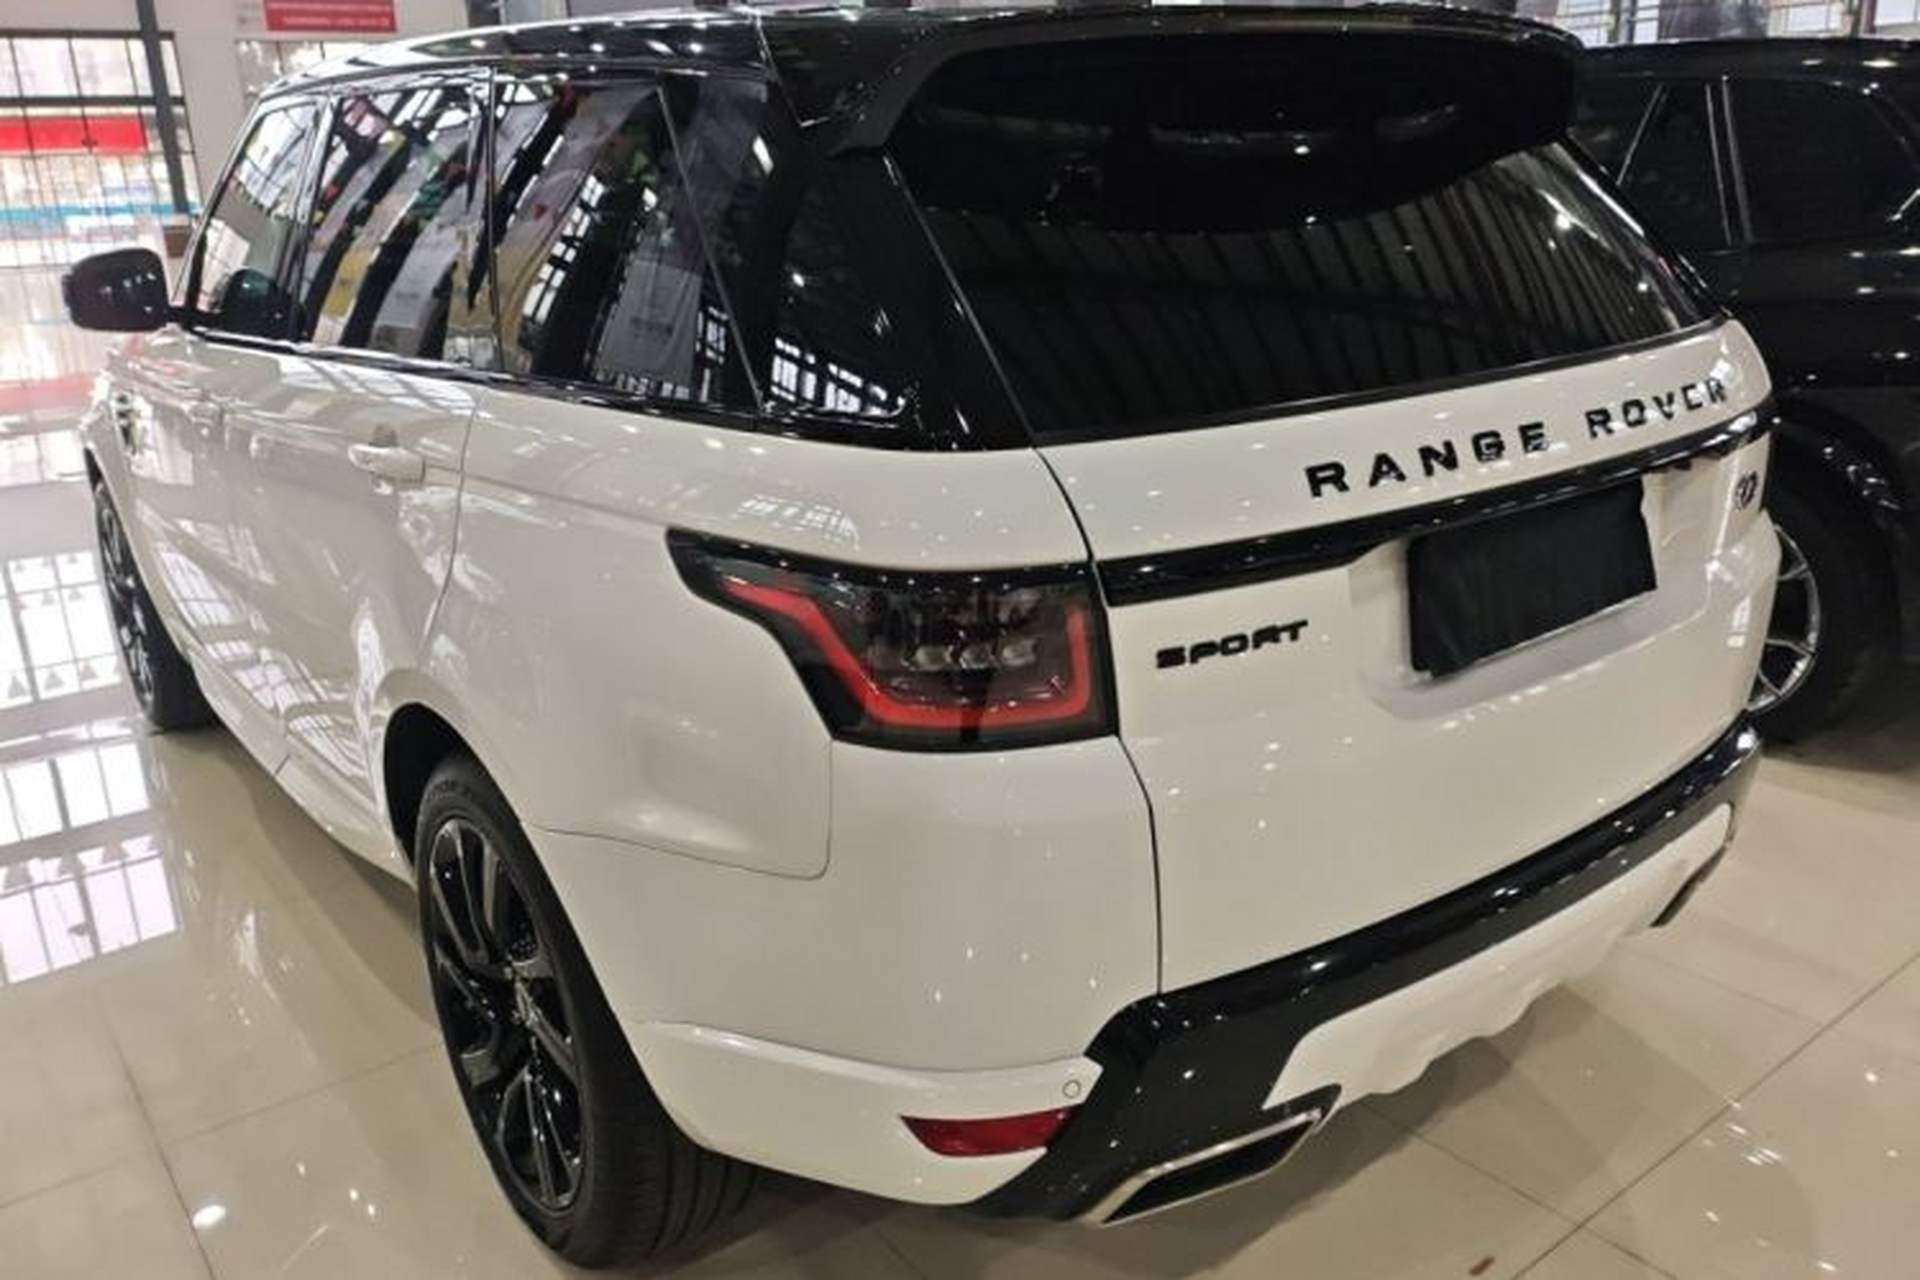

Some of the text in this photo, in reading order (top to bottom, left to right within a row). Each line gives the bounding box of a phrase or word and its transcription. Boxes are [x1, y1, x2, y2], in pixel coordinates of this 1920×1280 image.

[1305, 378, 1727, 497] RANGE ROVER
[1156, 619, 1308, 669] SPORT
